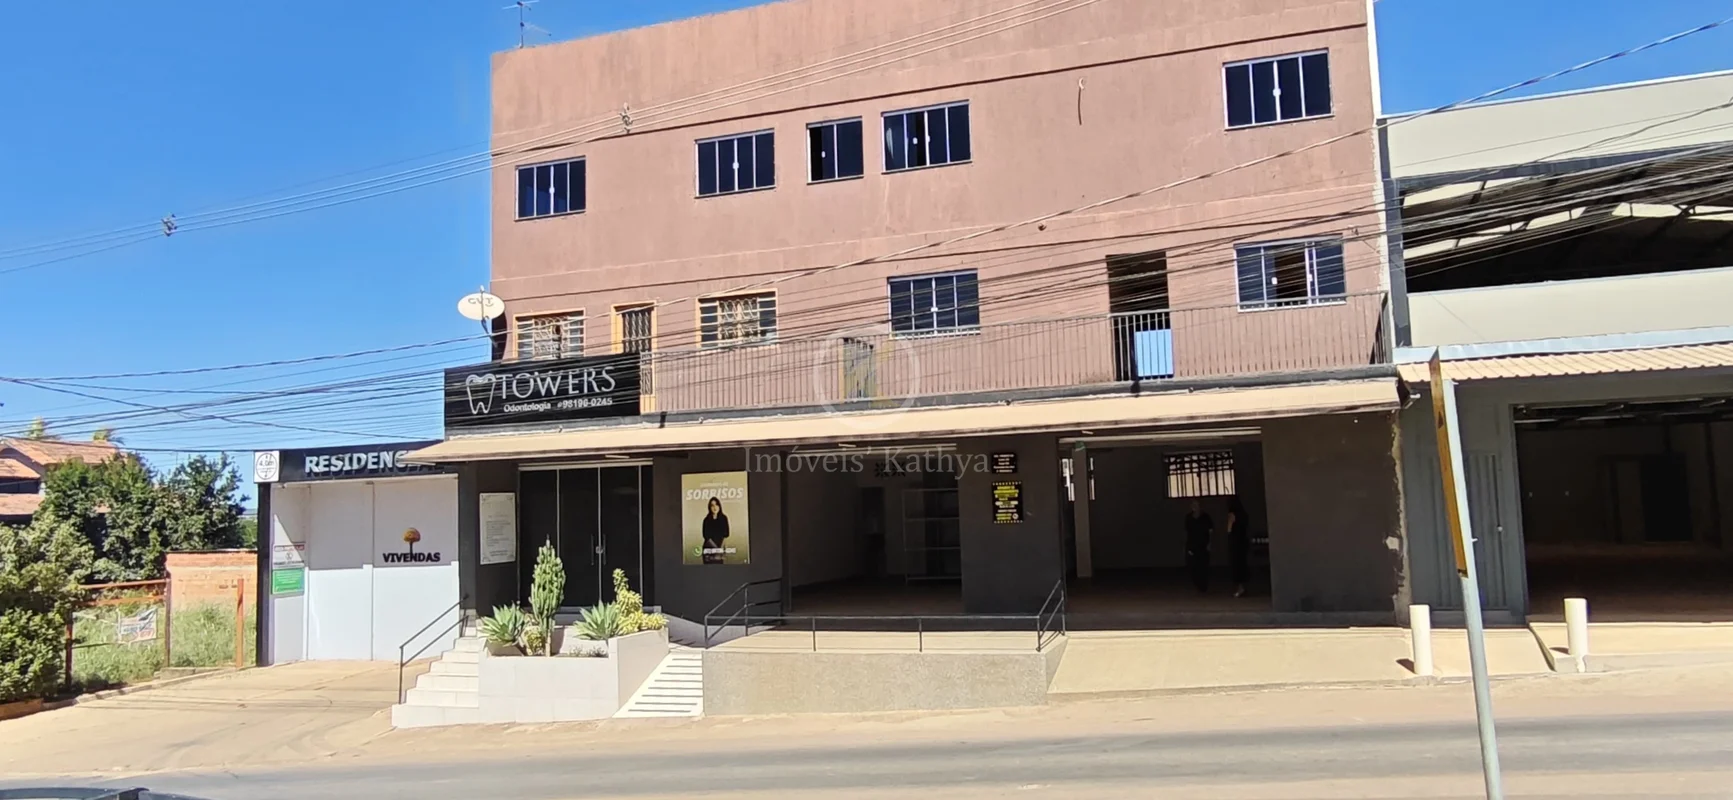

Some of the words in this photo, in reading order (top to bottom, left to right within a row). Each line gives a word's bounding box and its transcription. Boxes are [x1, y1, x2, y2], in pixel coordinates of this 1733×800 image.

[496, 366, 616, 399] TOWERS
[503, 402, 552, 413] Odontologia
[305, 450, 422, 473] RESIDENC
[382, 552, 441, 563] VIVENDAS
